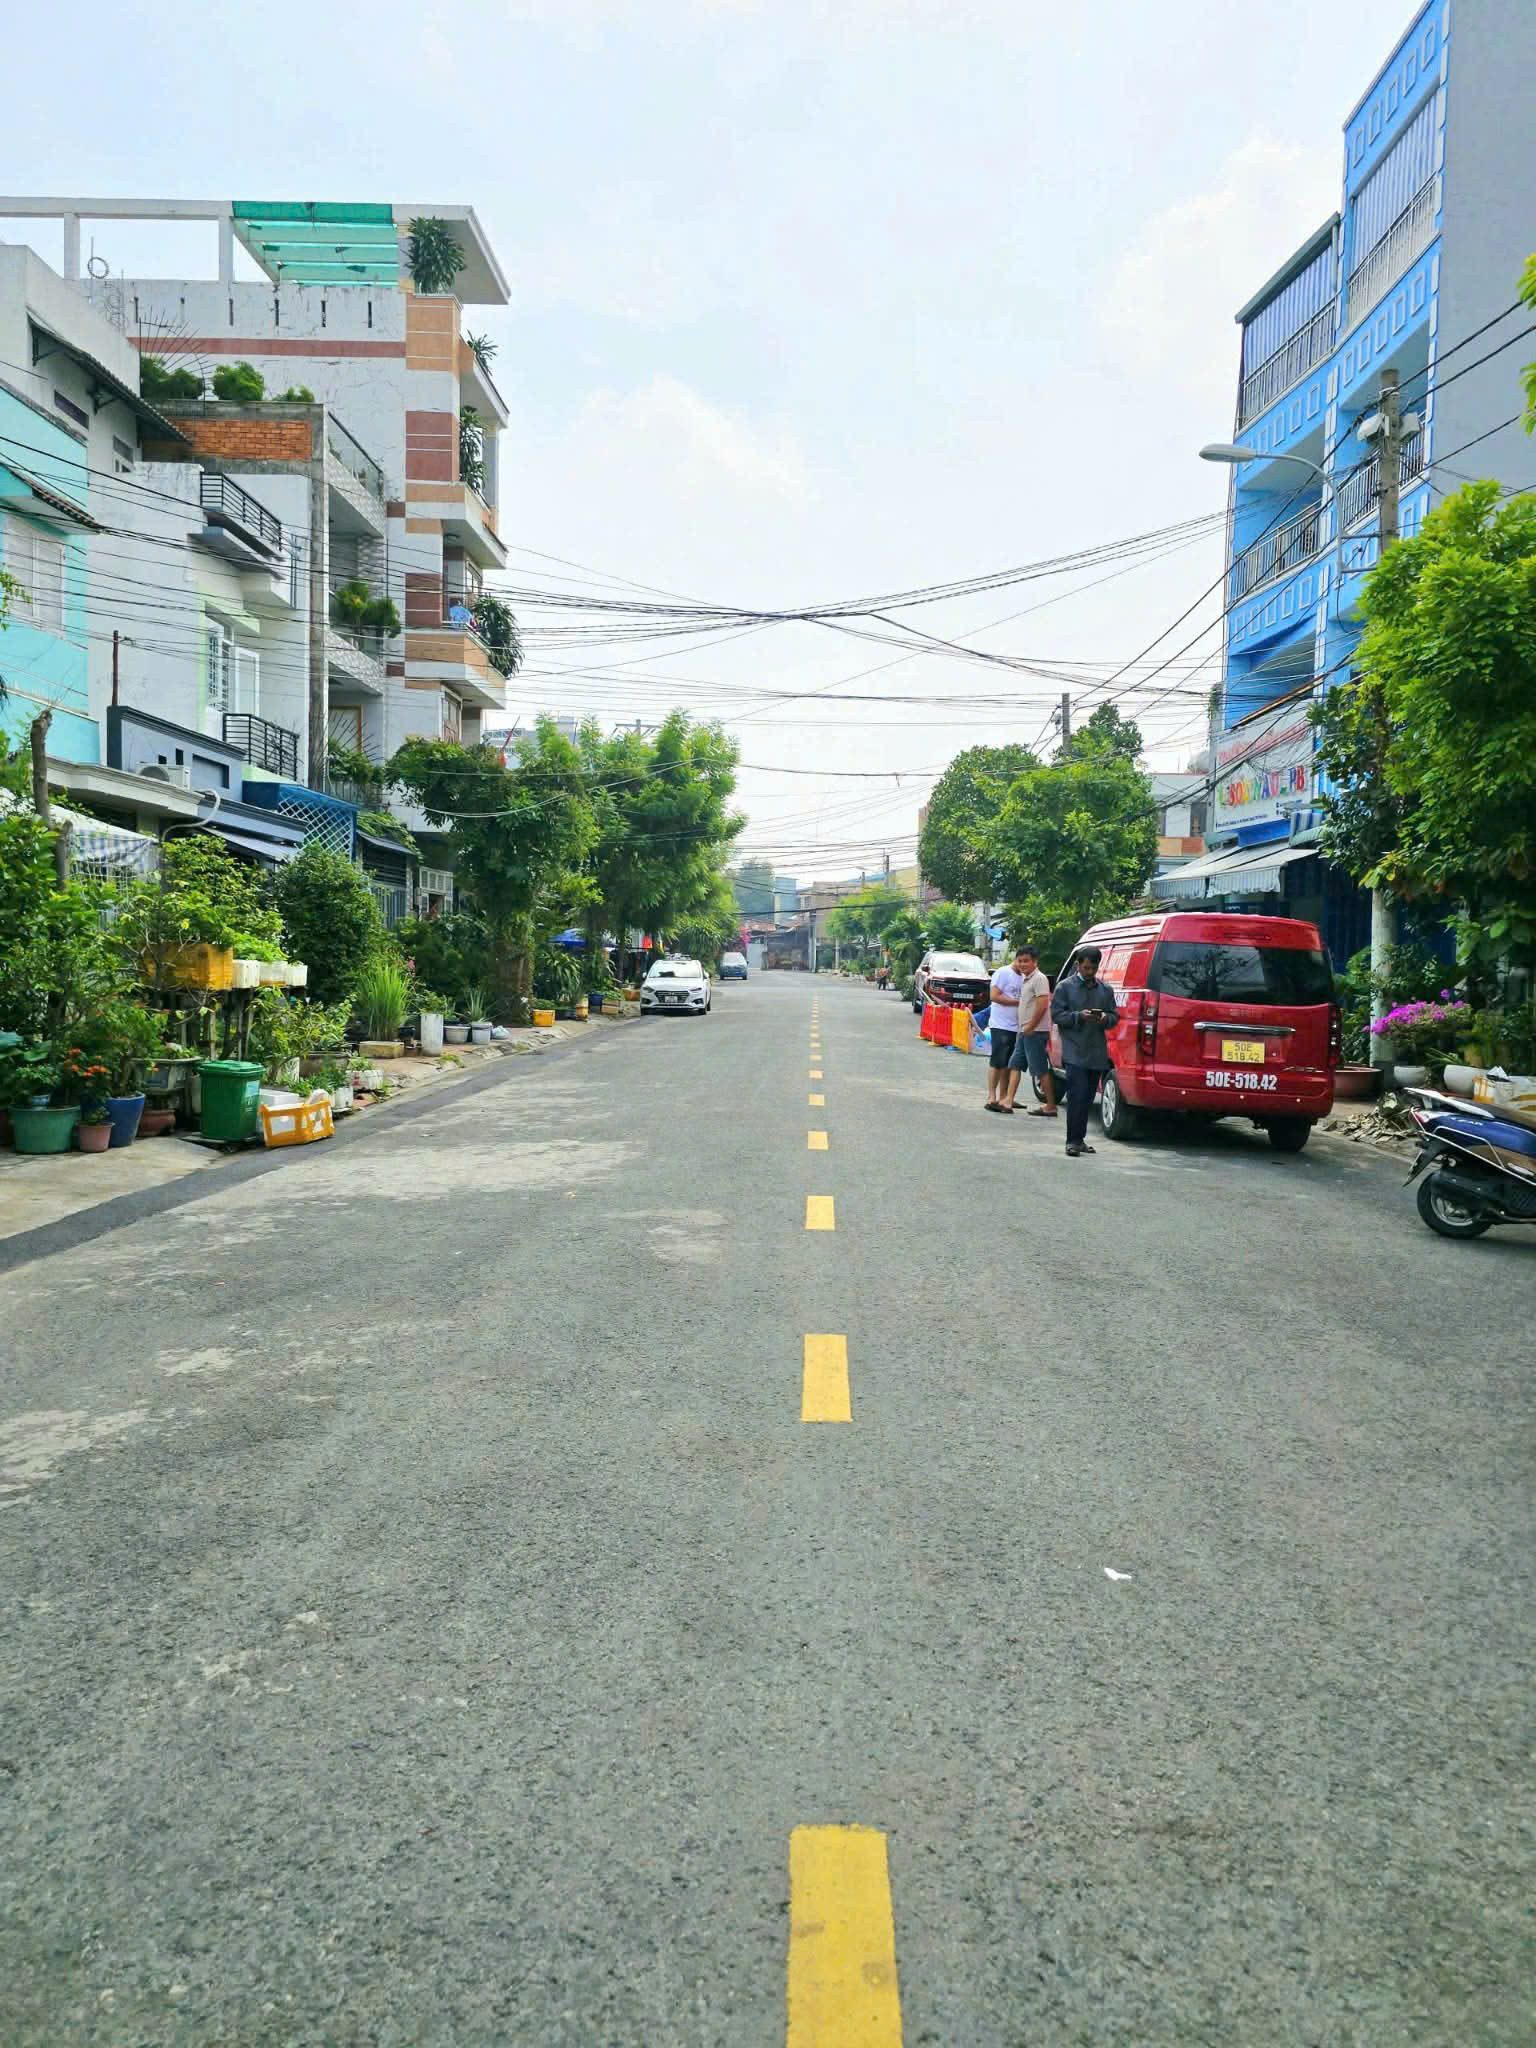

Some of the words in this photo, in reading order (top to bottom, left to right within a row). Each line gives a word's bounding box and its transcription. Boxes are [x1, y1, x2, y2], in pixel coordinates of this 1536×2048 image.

[1234, 1042, 1253, 1052] 50E
[1227, 1051, 1261, 1062] 518.42
[1205, 1071, 1278, 1091] 50E-518.42
